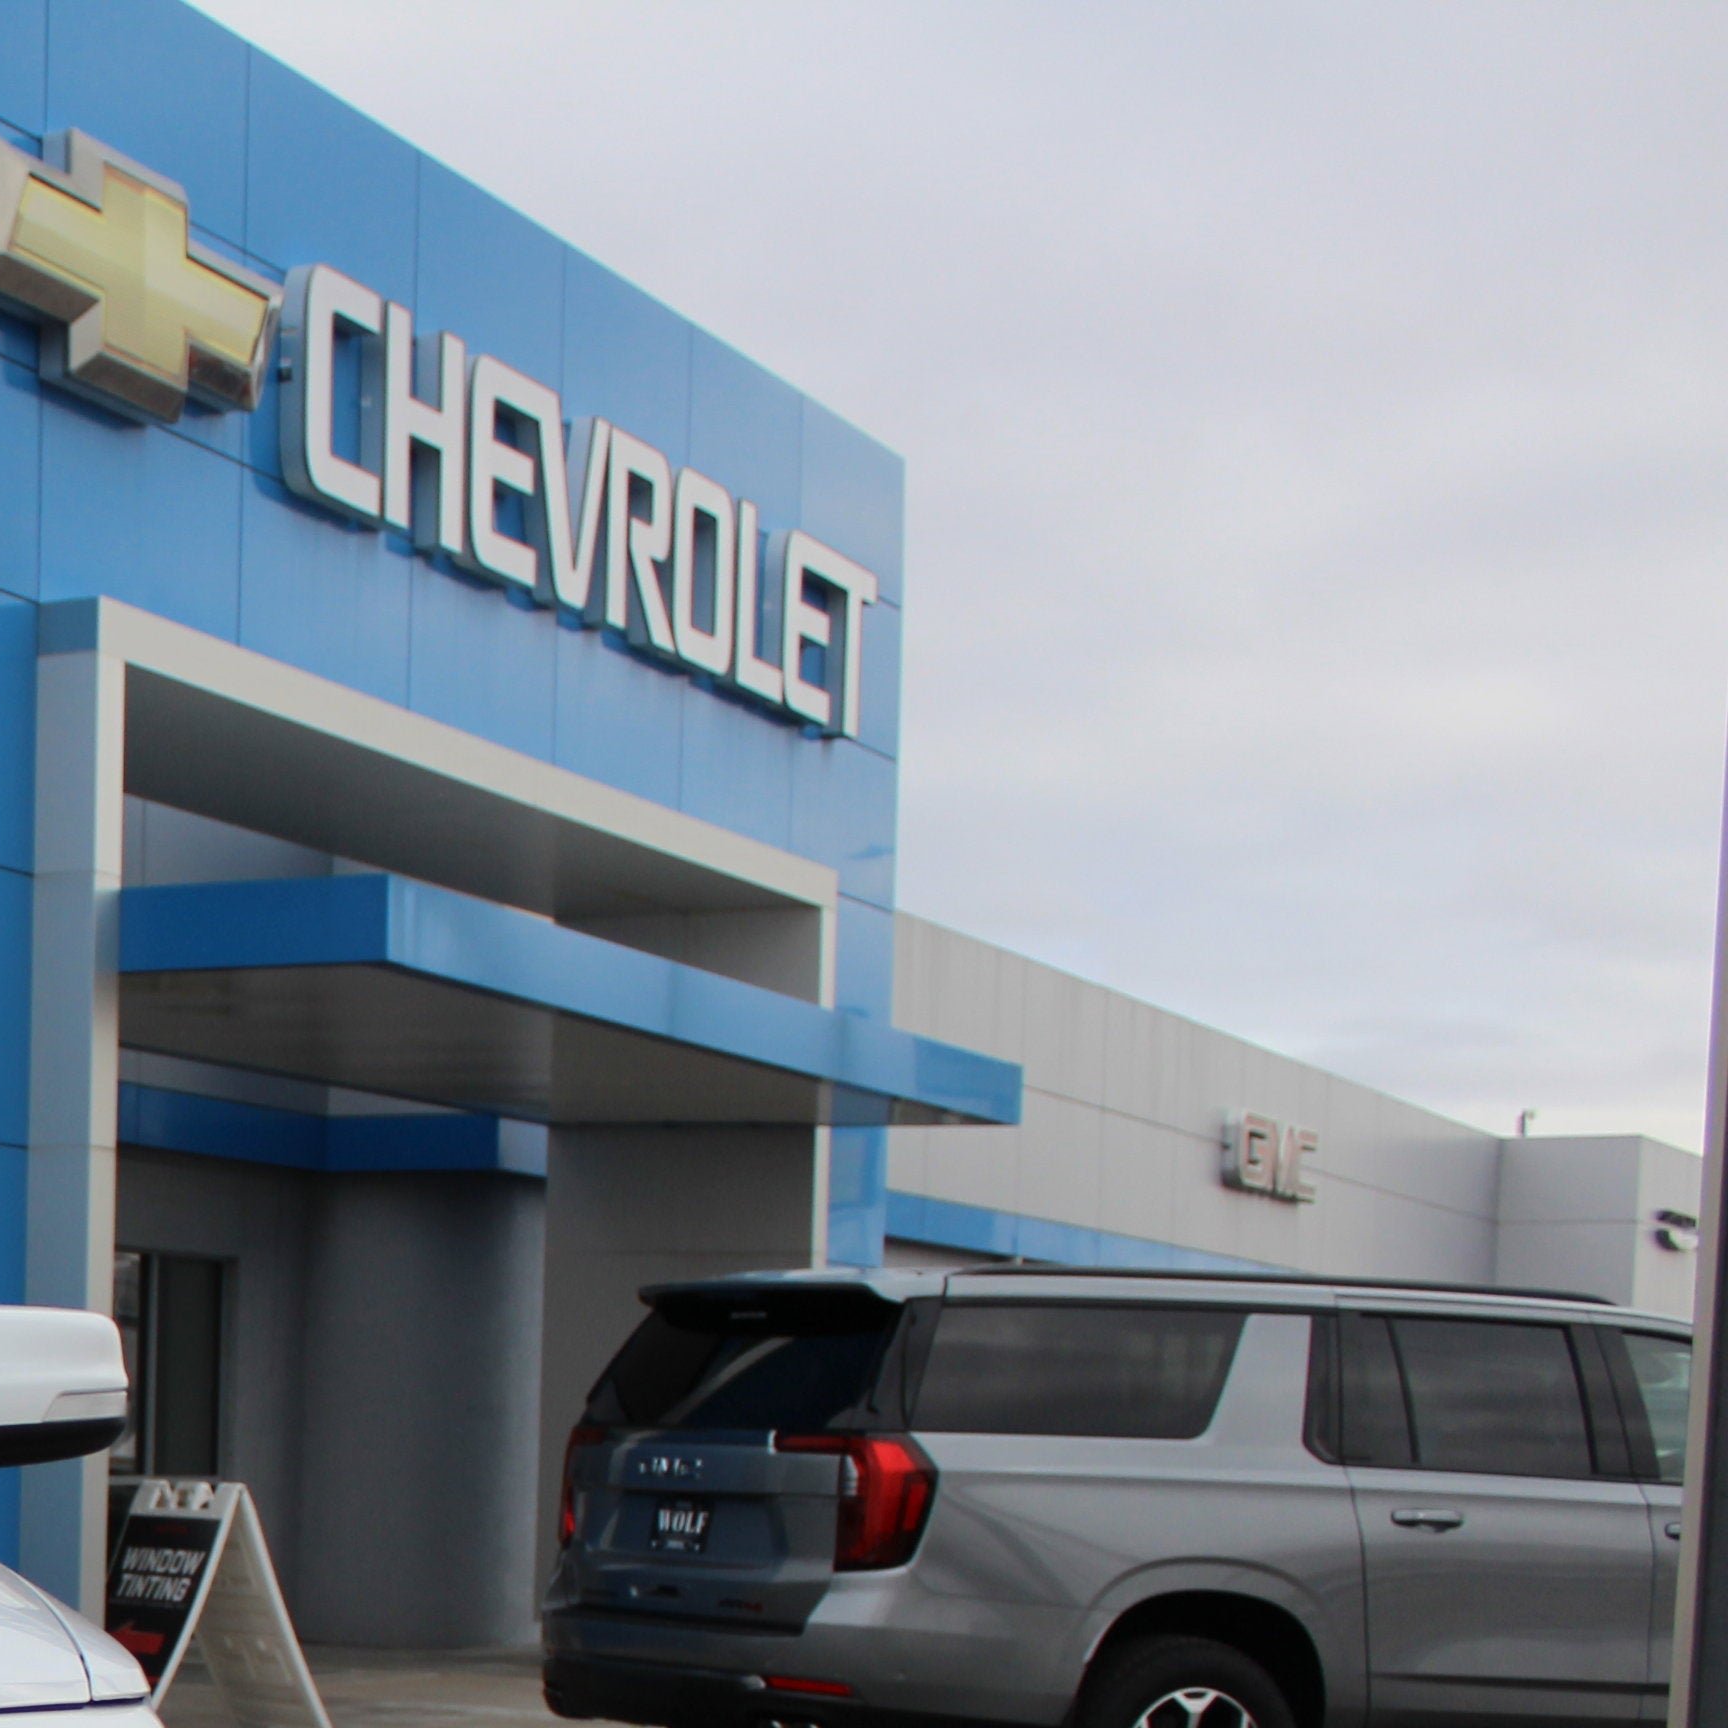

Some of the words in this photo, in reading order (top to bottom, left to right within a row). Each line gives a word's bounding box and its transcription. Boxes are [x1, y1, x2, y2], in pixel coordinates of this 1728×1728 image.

[280, 264, 877, 739] CHEVROLET
[658, 1508, 709, 1534] WOLF
[122, 1546, 206, 1575] WINDOW
[116, 1573, 192, 1602] TINTING
